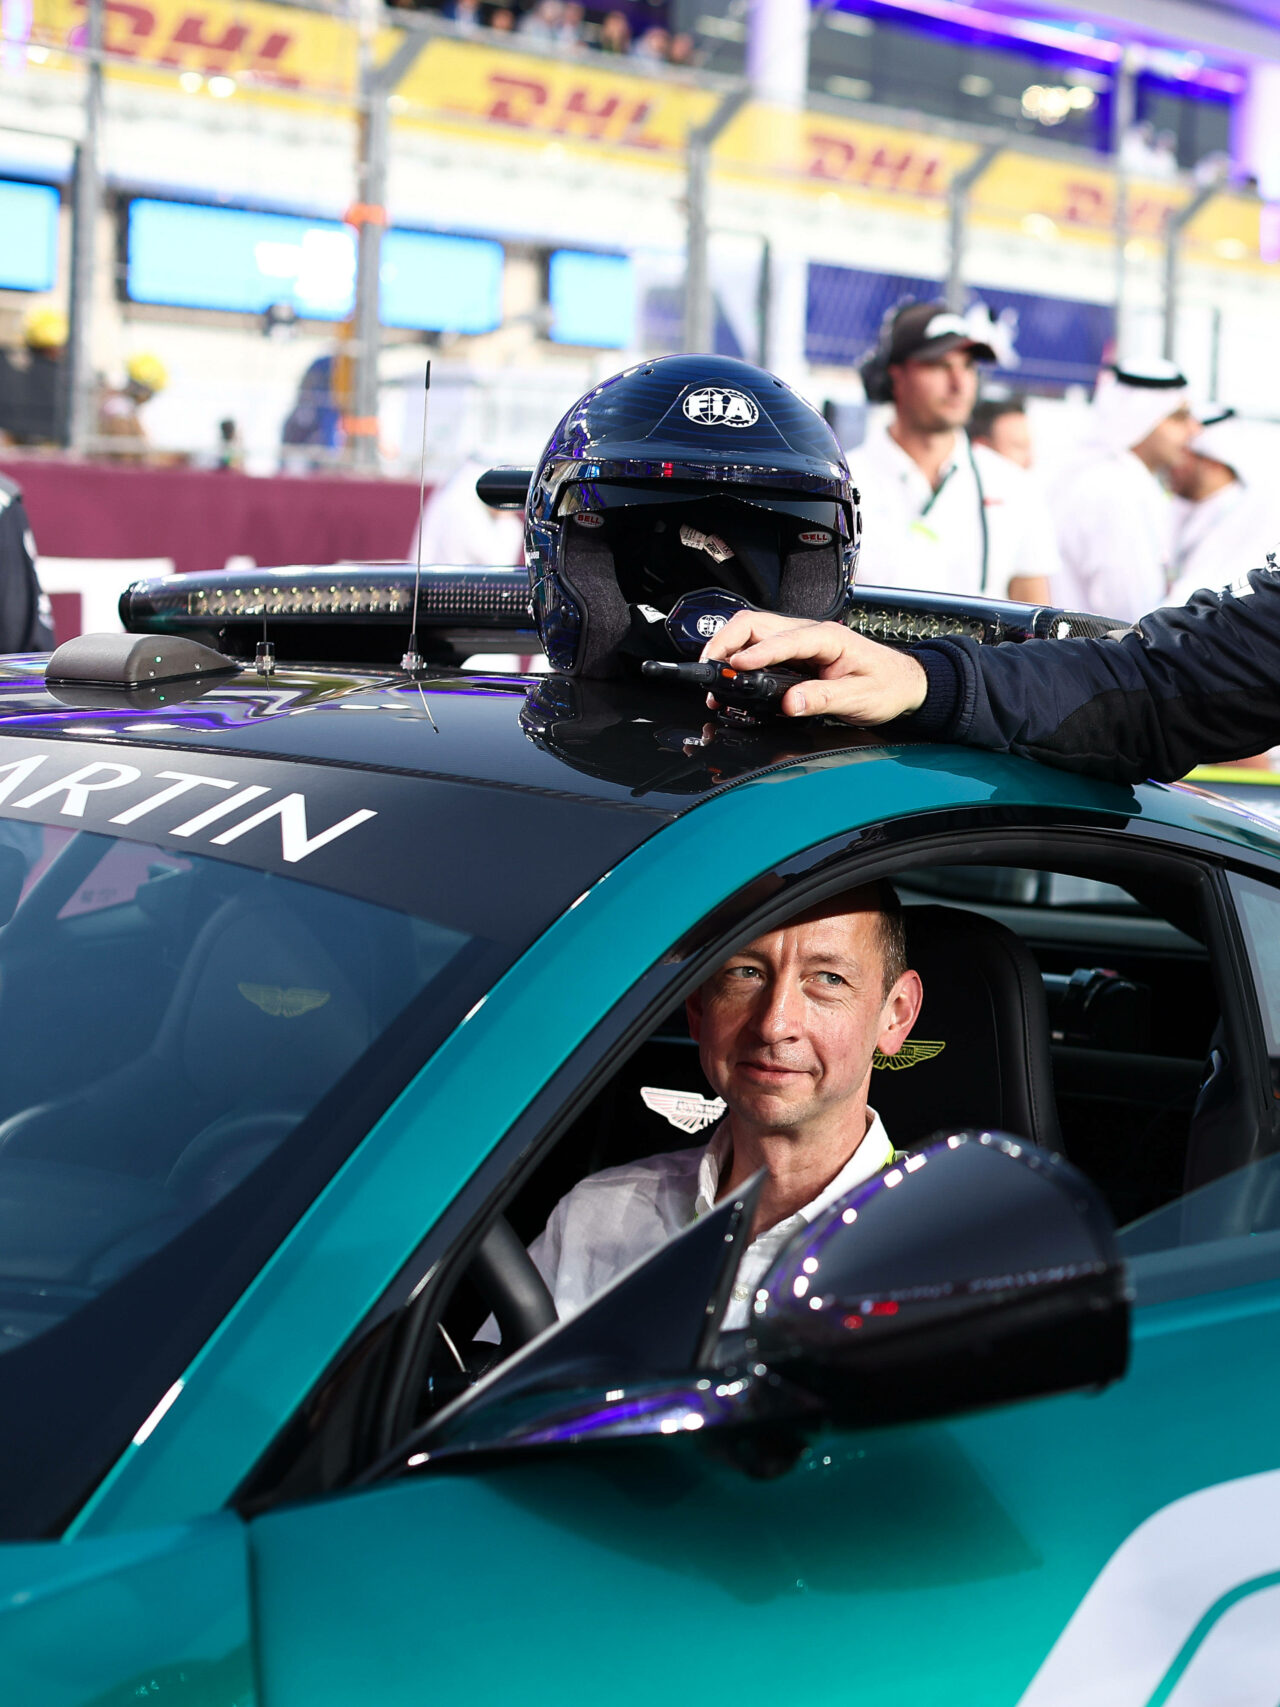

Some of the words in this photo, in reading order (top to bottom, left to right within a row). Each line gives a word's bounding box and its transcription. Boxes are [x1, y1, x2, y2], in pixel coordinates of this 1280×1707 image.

[487, 74, 663, 151] DHL
[804, 134, 944, 199] DHL
[801, 533, 828, 541] BELL
